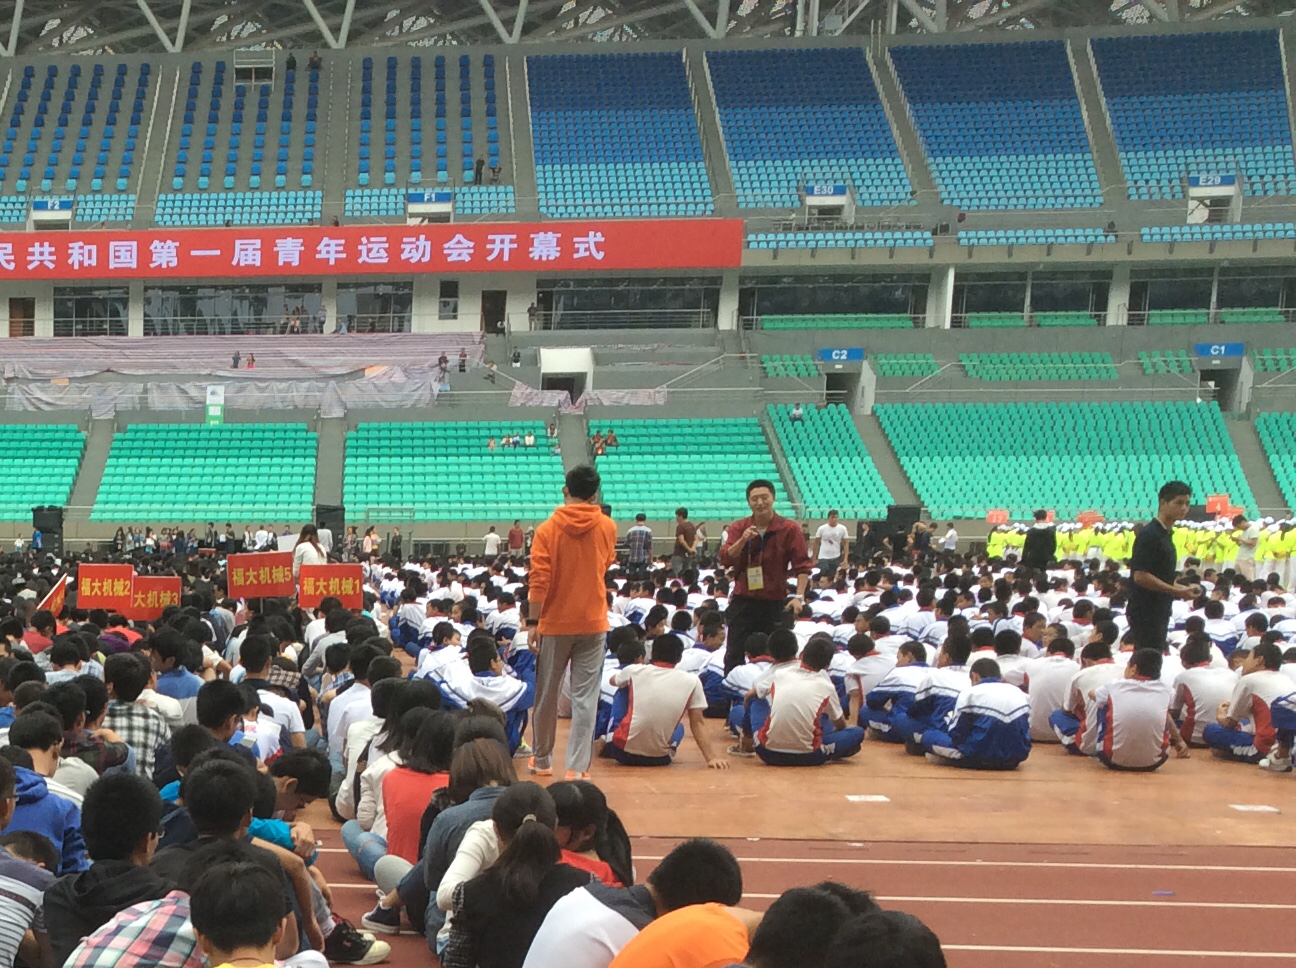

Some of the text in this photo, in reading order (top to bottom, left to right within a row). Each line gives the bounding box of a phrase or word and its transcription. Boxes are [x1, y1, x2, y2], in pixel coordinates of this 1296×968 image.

[813, 186, 834, 194] E30
[424, 193, 436, 201] F1
[47, 201, 60, 209] F2
[831, 350, 848, 359] C2
[1210, 346, 1226, 355] C1
[232, 566, 292, 586] 福大机械5
[81, 577, 131, 596] 福大机械2
[302, 577, 360, 595] 福大机械1
